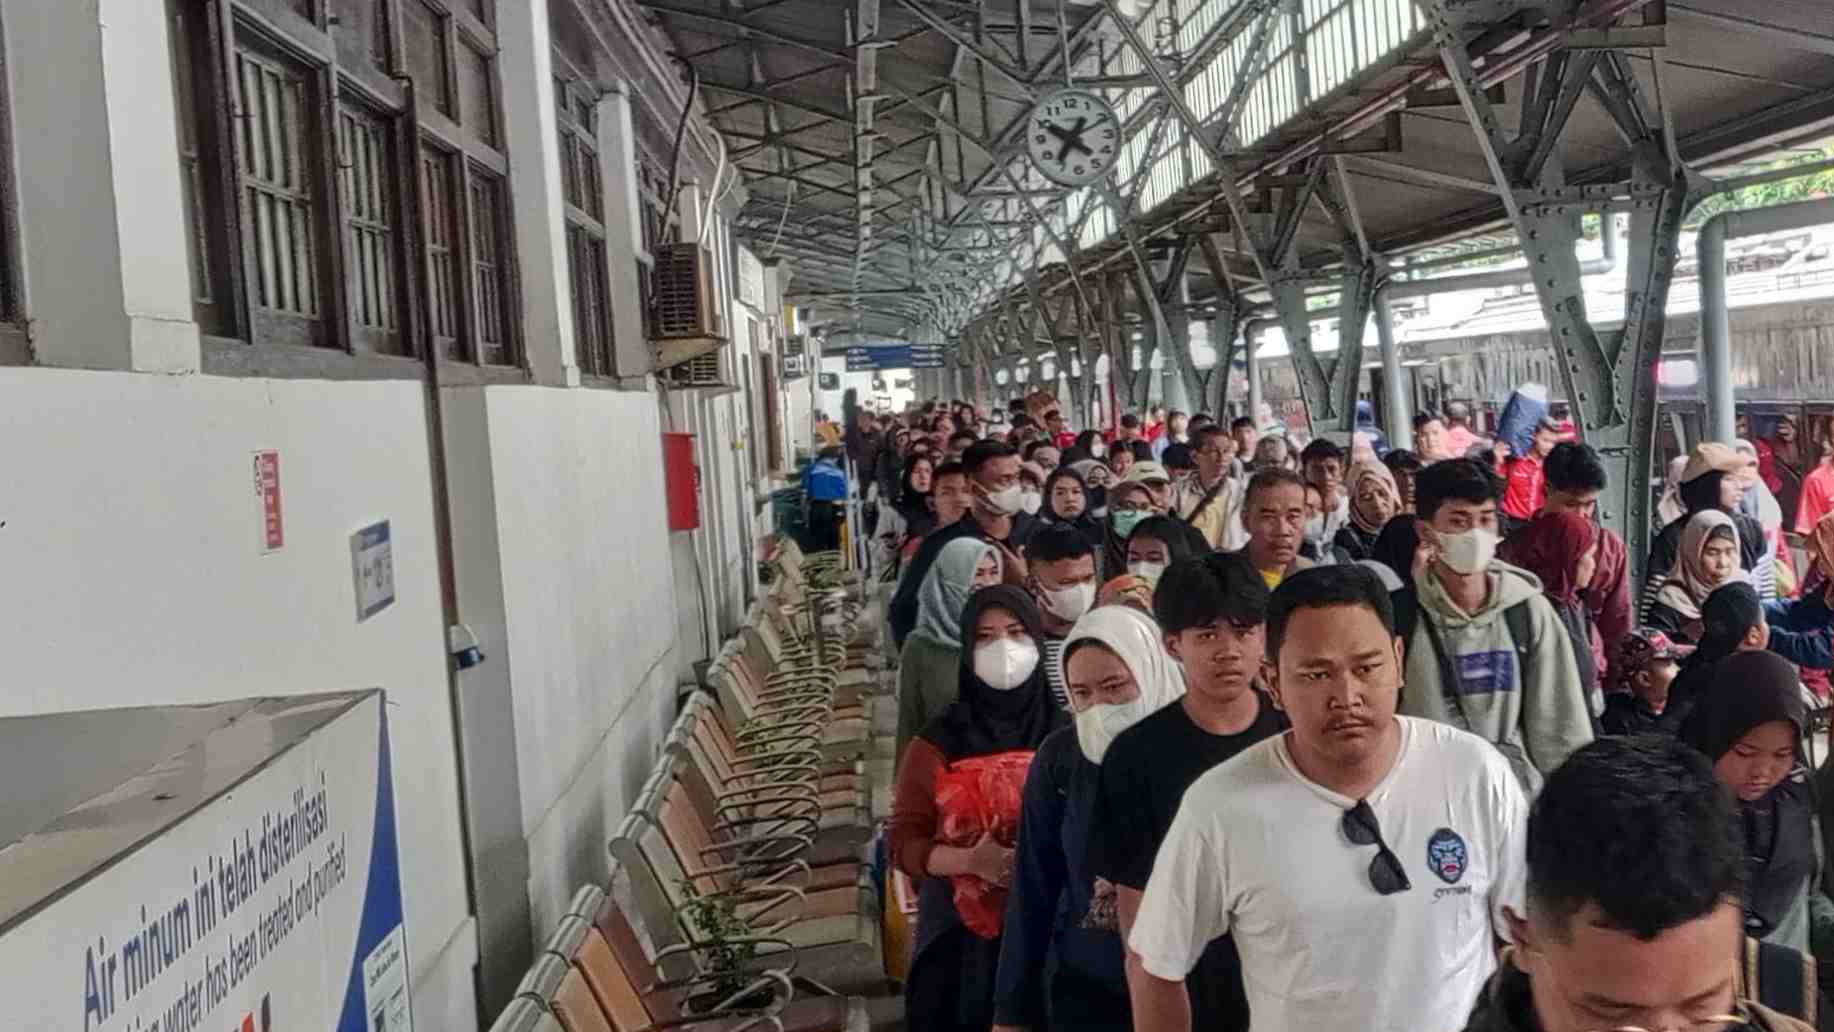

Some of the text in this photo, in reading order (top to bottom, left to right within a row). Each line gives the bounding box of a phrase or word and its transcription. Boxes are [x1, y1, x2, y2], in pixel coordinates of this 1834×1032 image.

[1063, 98, 1078, 109] 12
[1045, 106, 1060, 116] 11
[1103, 129, 1114, 140] 3
[1100, 145, 1112, 154] 4
[123, 905, 192, 1001] minum
[193, 856, 216, 938] ini
[218, 828, 257, 919] telah
[259, 772, 328, 884] disterilisasi
[205, 955, 228, 1014] has
[228, 933, 257, 990] been
[257, 878, 294, 958] treated
[294, 864, 314, 923] and
[313, 831, 347, 917] purified
